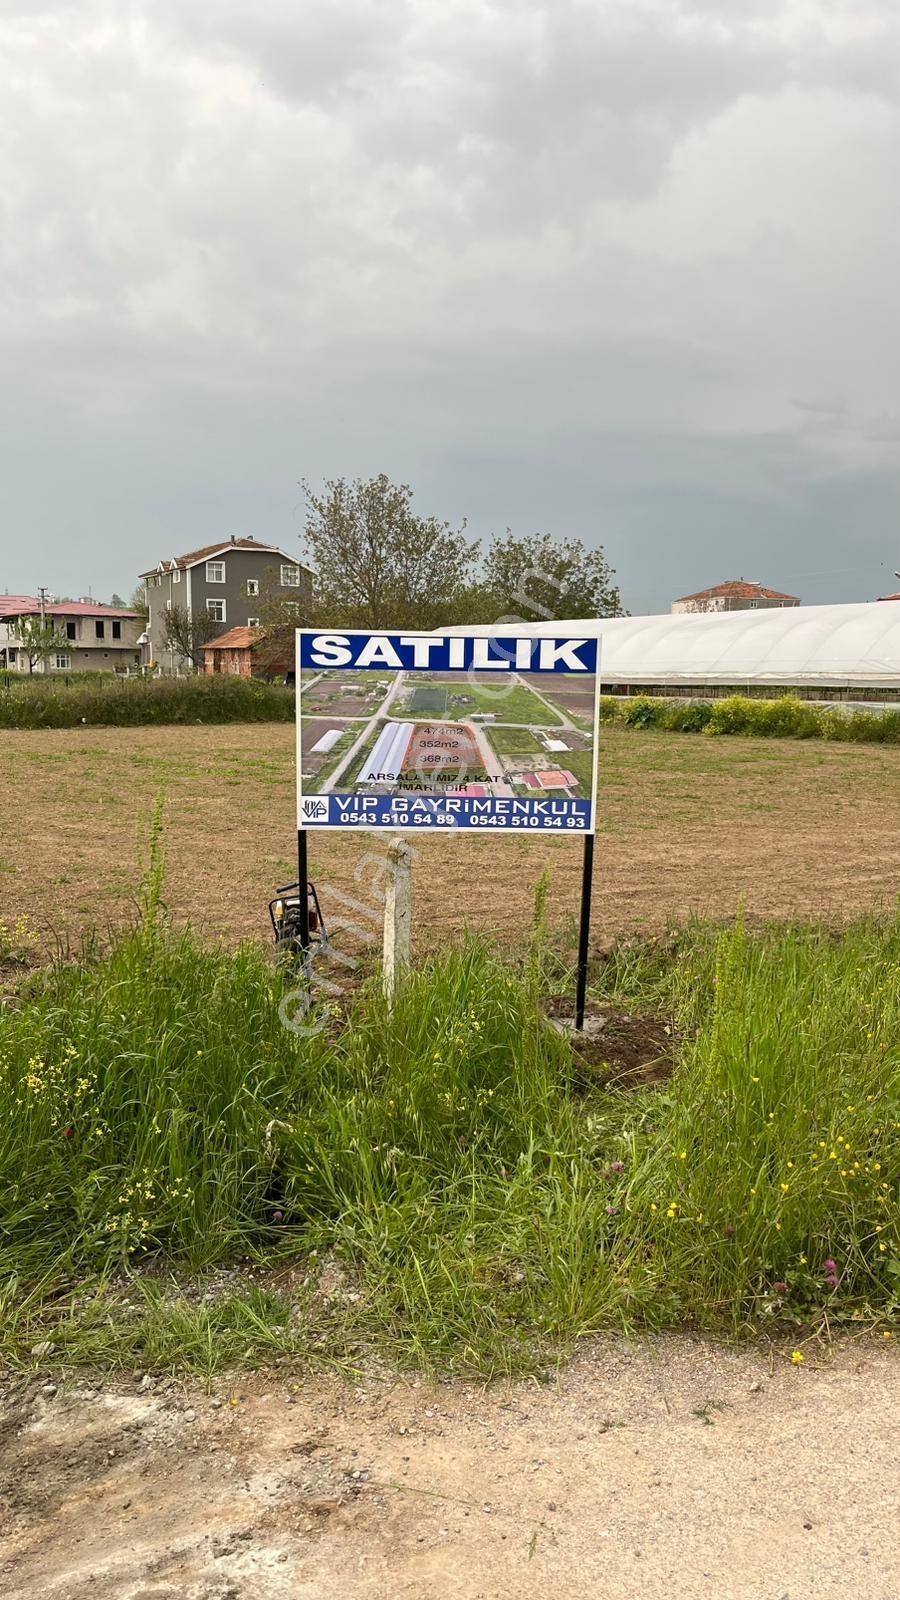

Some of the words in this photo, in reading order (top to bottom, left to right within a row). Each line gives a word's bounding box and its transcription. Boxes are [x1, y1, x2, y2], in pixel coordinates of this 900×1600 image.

[310, 635, 588, 670] SATILIK
[474, 775, 501, 783] KAT
[340, 812, 377, 823] 0543
[381, 813, 409, 824] 510
[413, 814, 433, 825] 54
[436, 815, 455, 825] 89
[469, 815, 507, 826] 0543
[511, 816, 539, 827] 510
[543, 817, 562, 827] 54
[566, 817, 585, 828] 93
